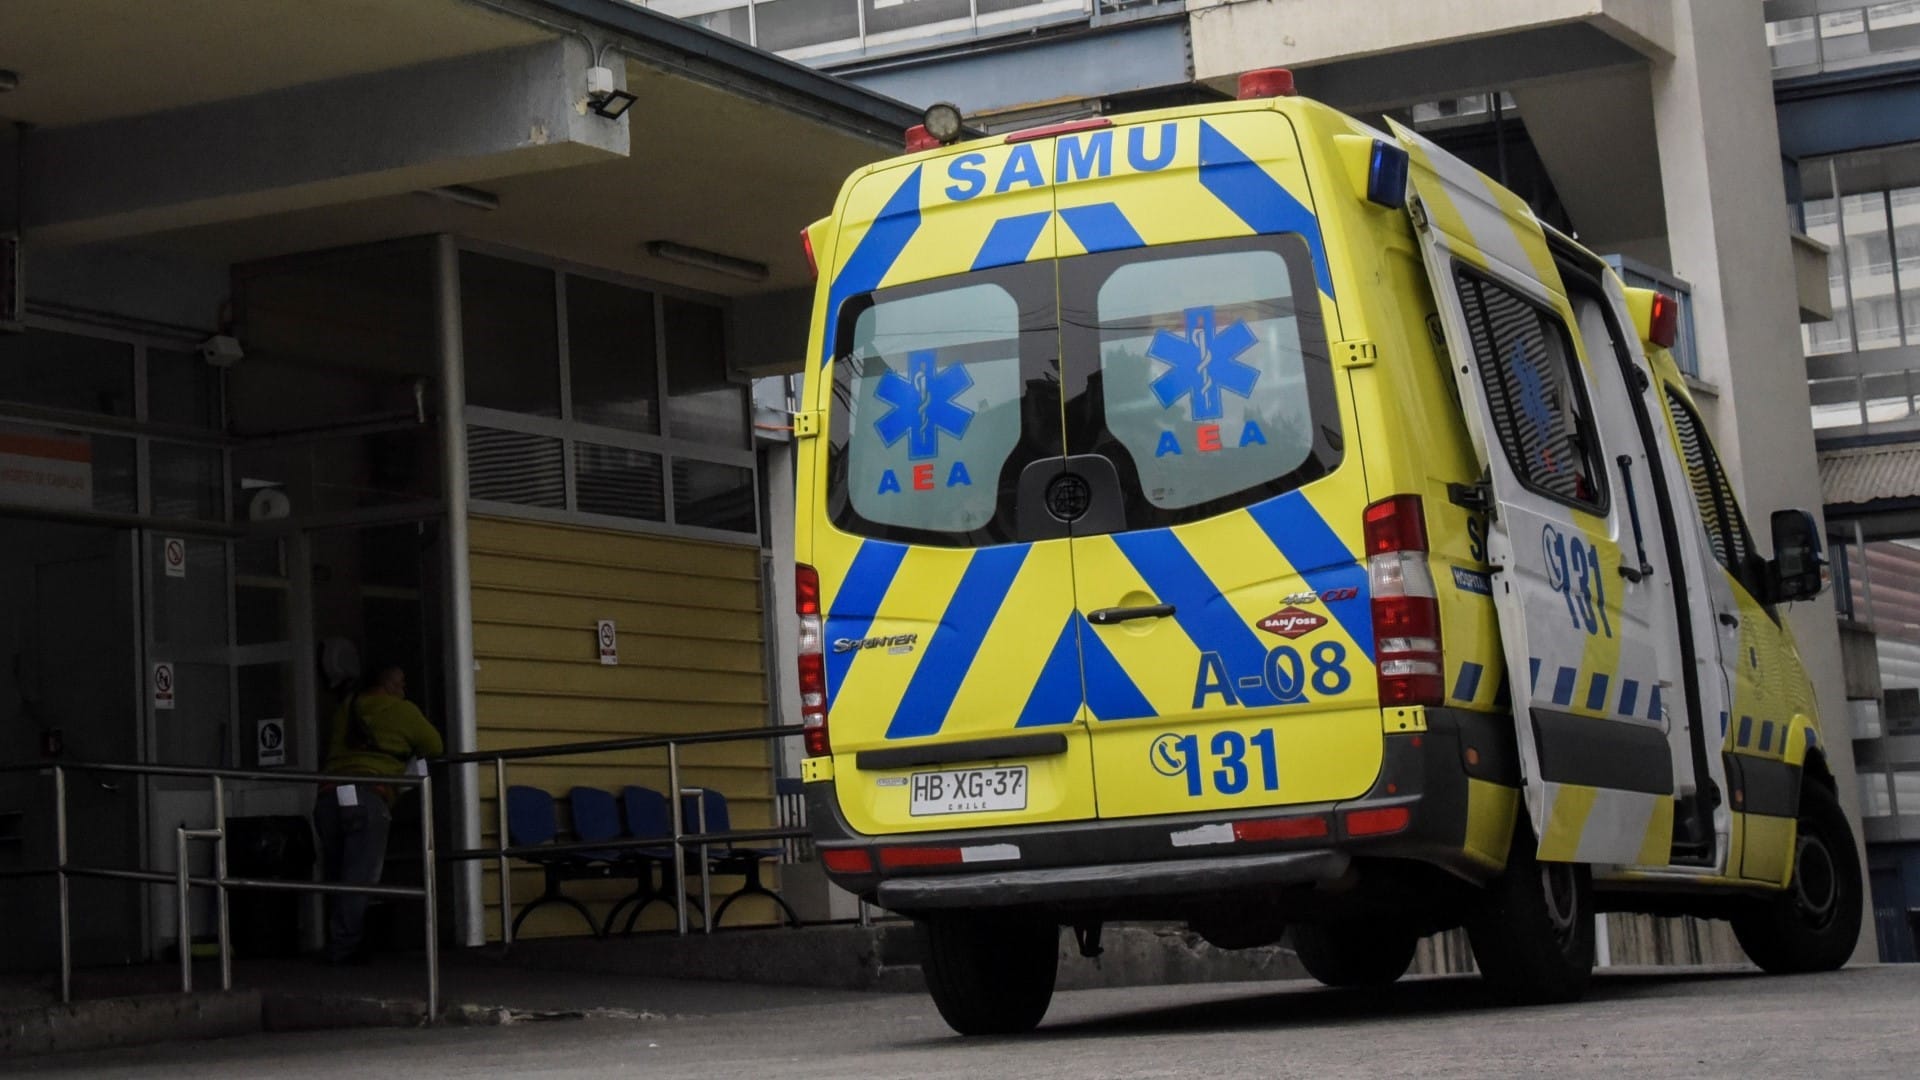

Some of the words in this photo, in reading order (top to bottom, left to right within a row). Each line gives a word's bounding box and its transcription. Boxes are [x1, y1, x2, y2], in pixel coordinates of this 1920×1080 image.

[944, 122, 1178, 202] SAMU
[1155, 419, 1267, 458] AEA
[877, 461, 973, 495] AEA
[1321, 587, 1359, 602] CDI
[1554, 532, 1613, 639] 131
[1191, 640, 1352, 710] A-08
[1175, 728, 1279, 797] 131
